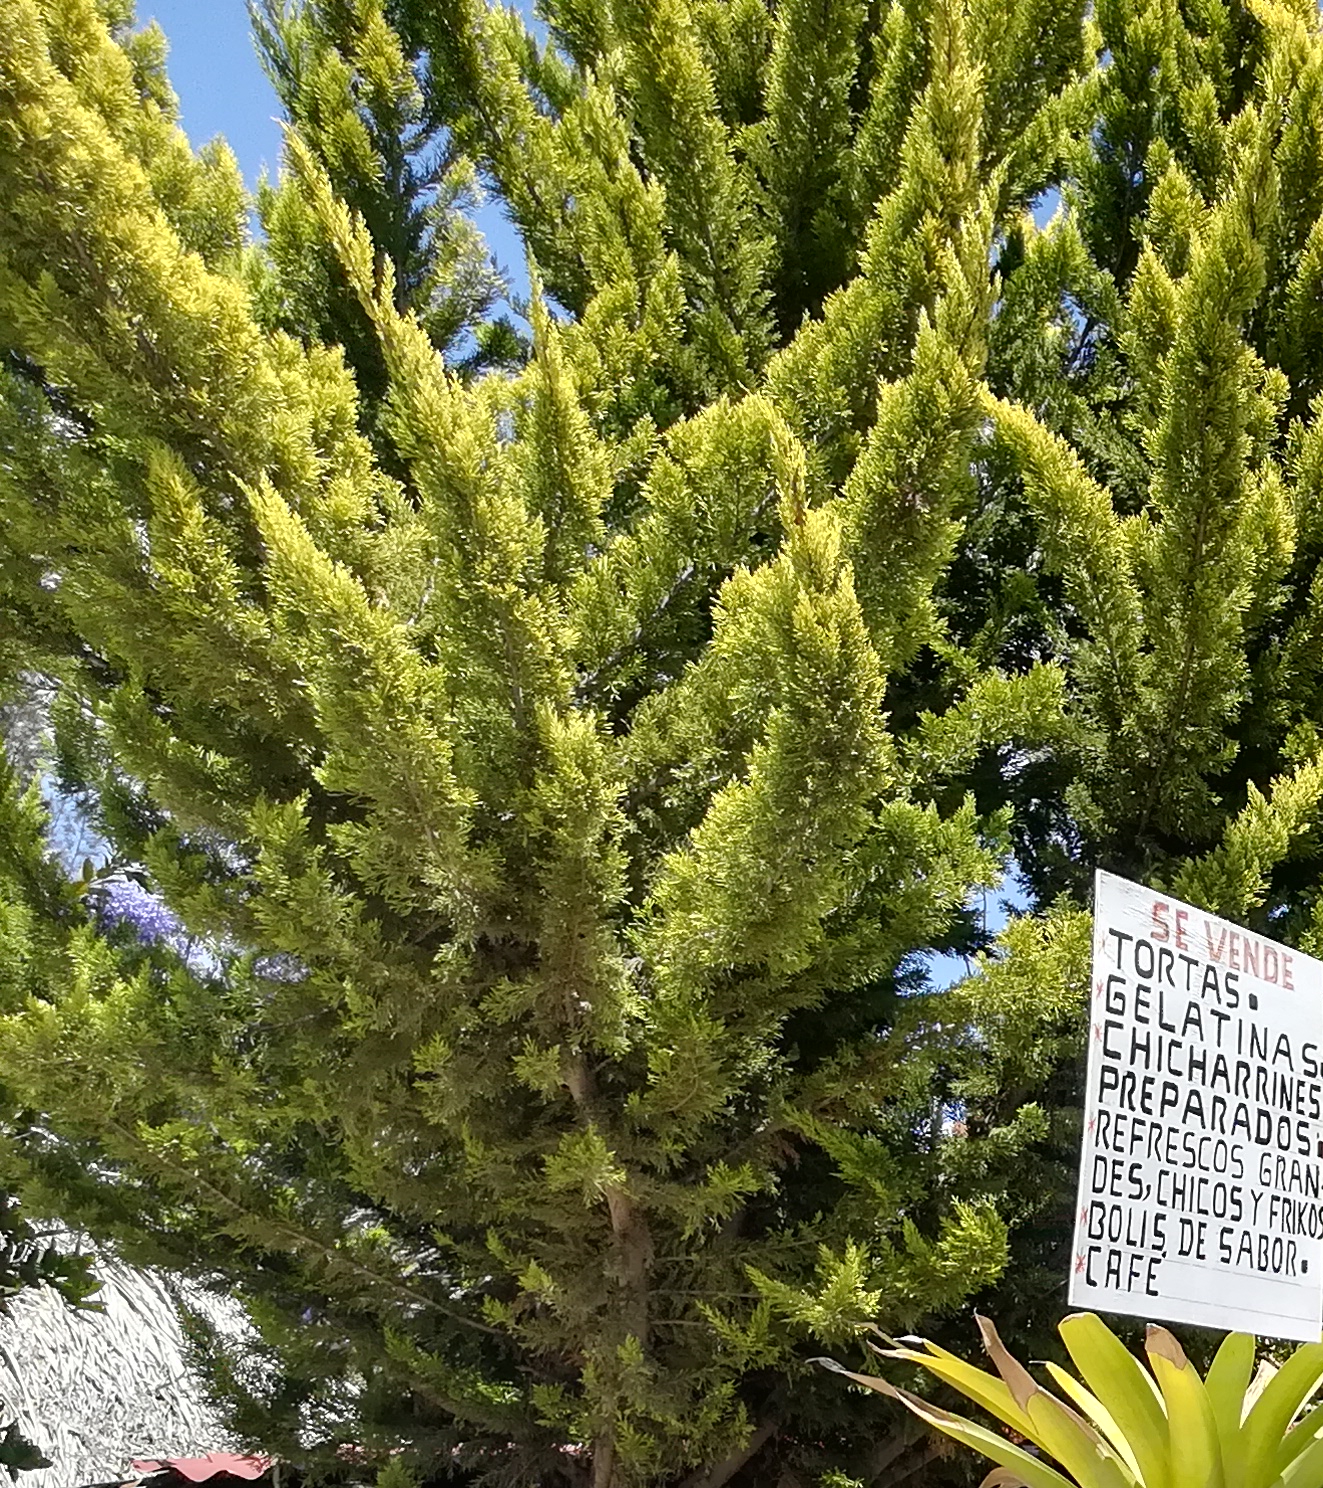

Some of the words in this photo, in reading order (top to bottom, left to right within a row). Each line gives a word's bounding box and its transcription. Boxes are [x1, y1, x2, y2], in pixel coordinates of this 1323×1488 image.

[1150, 901, 1188, 951] SE
[1204, 920, 1294, 991] VENDE
[1095, 1109, 1244, 1179] REFRESCOS
[1088, 1200, 1167, 1250] BOLIS
[1178, 1217, 1207, 1260] DE
[1157, 1169, 1243, 1222] CHICOS
[1250, 1189, 1264, 1226] Y
